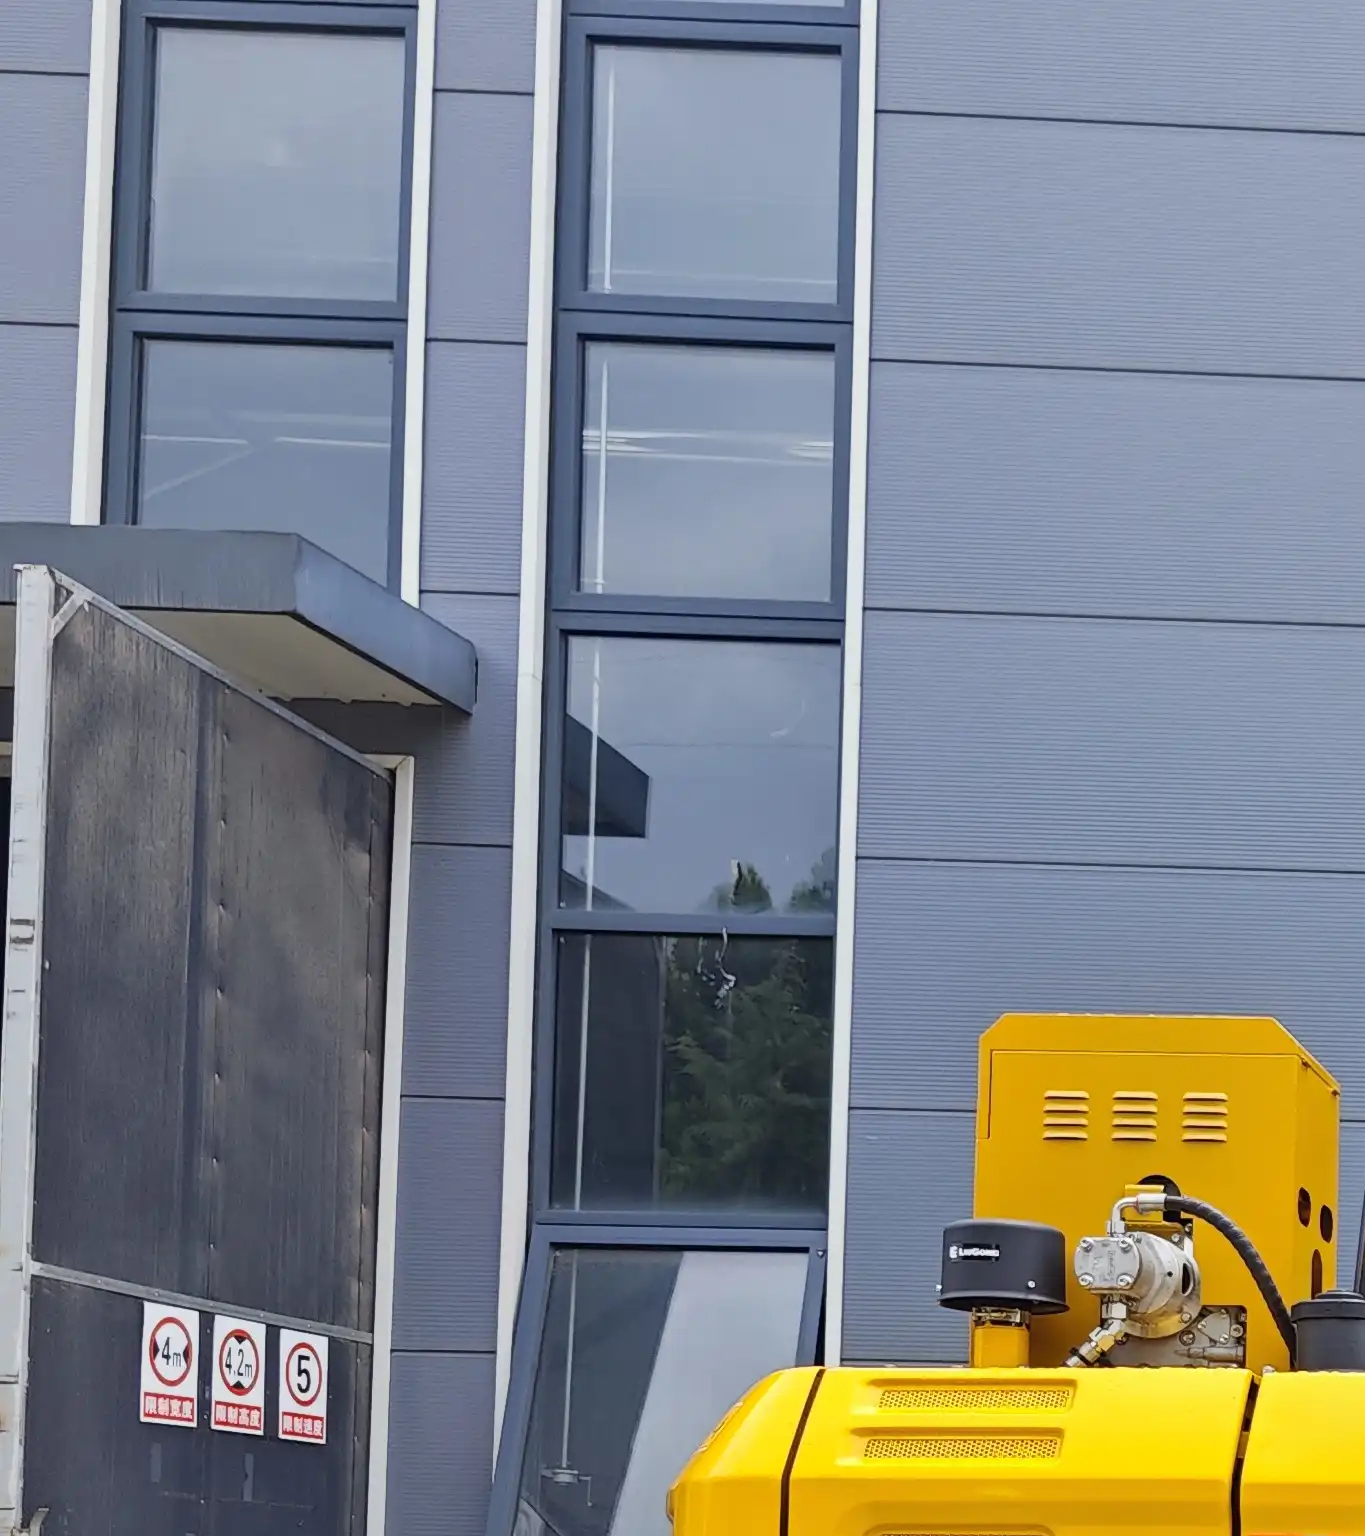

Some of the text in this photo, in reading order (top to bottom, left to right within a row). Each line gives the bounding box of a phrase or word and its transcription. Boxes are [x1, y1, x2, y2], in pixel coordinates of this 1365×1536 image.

[224, 1347, 253, 1378] 4.2m
[296, 1355, 311, 1394] 5
[144, 1395, 194, 1420] 限制宽度
[214, 1404, 262, 1428] 限制高度
[282, 1414, 324, 1438] 限制速度
